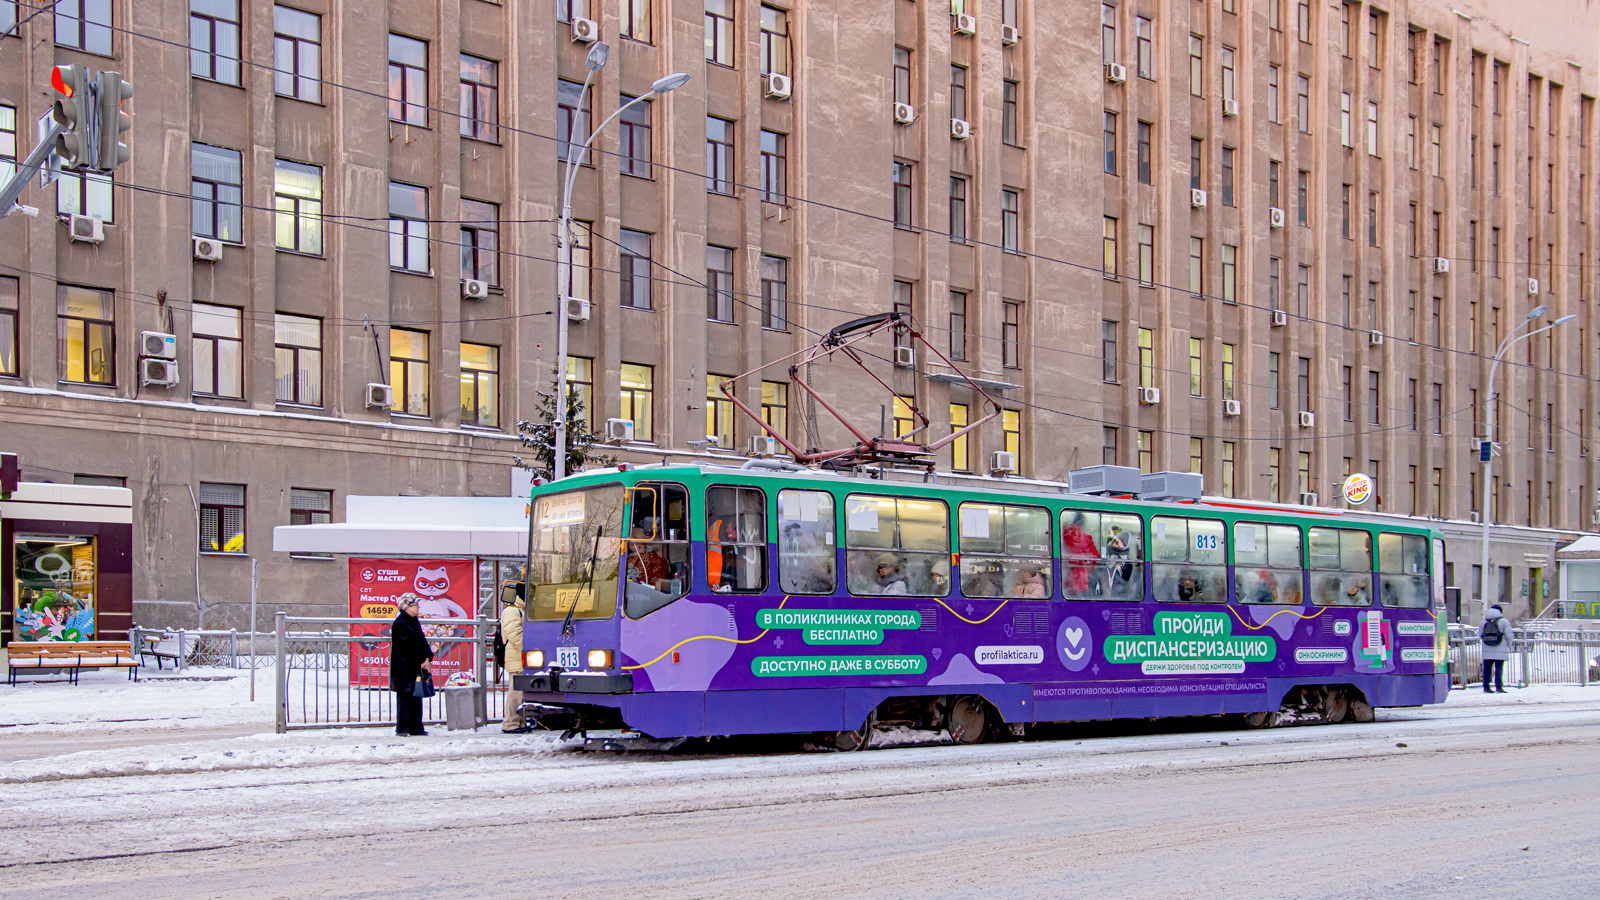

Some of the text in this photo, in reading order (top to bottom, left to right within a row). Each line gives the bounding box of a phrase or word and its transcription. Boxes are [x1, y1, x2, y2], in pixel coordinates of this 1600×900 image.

[1348, 485, 1368, 498] KING
[541, 501, 550, 519] 12
[1197, 534, 1217, 549] 813
[360, 594, 389, 604] Мастер
[764, 614, 916, 626] В ПОЛИКЛИНИКАХ ГОРОДА
[1161, 614, 1224, 637] ПРОЙДИ
[1337, 624, 1348, 632] ЭКГ
[810, 630, 878, 641] БЕСПЛАТНО
[981, 650, 1038, 662] profilaktica.ru
[1113, 640, 1268, 660] ДИСПАНСЕРИЗАЦИЮ
[1298, 651, 1345, 659] ОНКОСКРИНИНГ
[560, 652, 578, 666] 813
[760, 659, 921, 673] ДОСТУПНО ДАЖЕ В СУББОТУ
[1033, 682, 1266, 697] ИМЕЮТСЯ ПРОТИВОПОКАЗАНИЯ, НЕОБХОДИМА КОНСУЛЬТАЦИЯ СПЕЦИАЛИСТА
